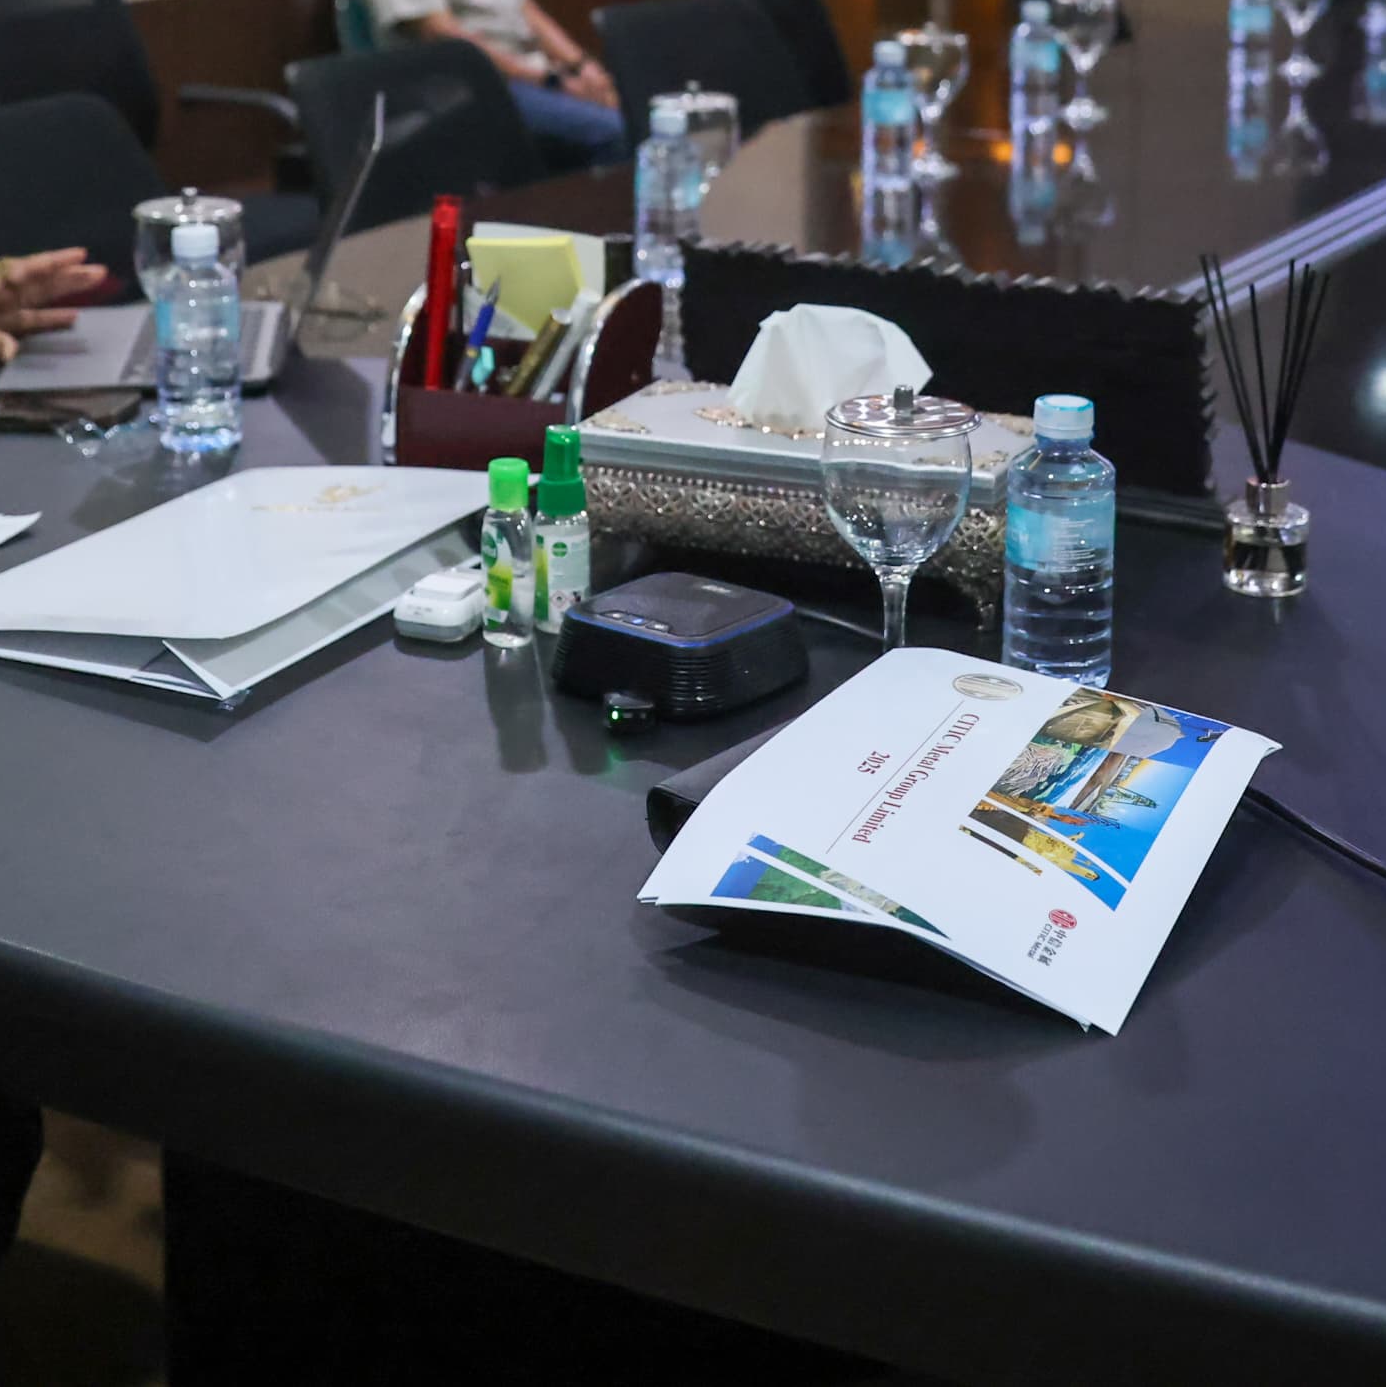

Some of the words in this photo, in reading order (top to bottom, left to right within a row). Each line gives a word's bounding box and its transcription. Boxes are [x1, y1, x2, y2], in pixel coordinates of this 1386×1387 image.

[941, 713, 980, 744] CITIC
[857, 751, 891, 774] 2025
[917, 742, 955, 770] Metal
[885, 770, 929, 800] Group
[851, 800, 902, 844] Limited
